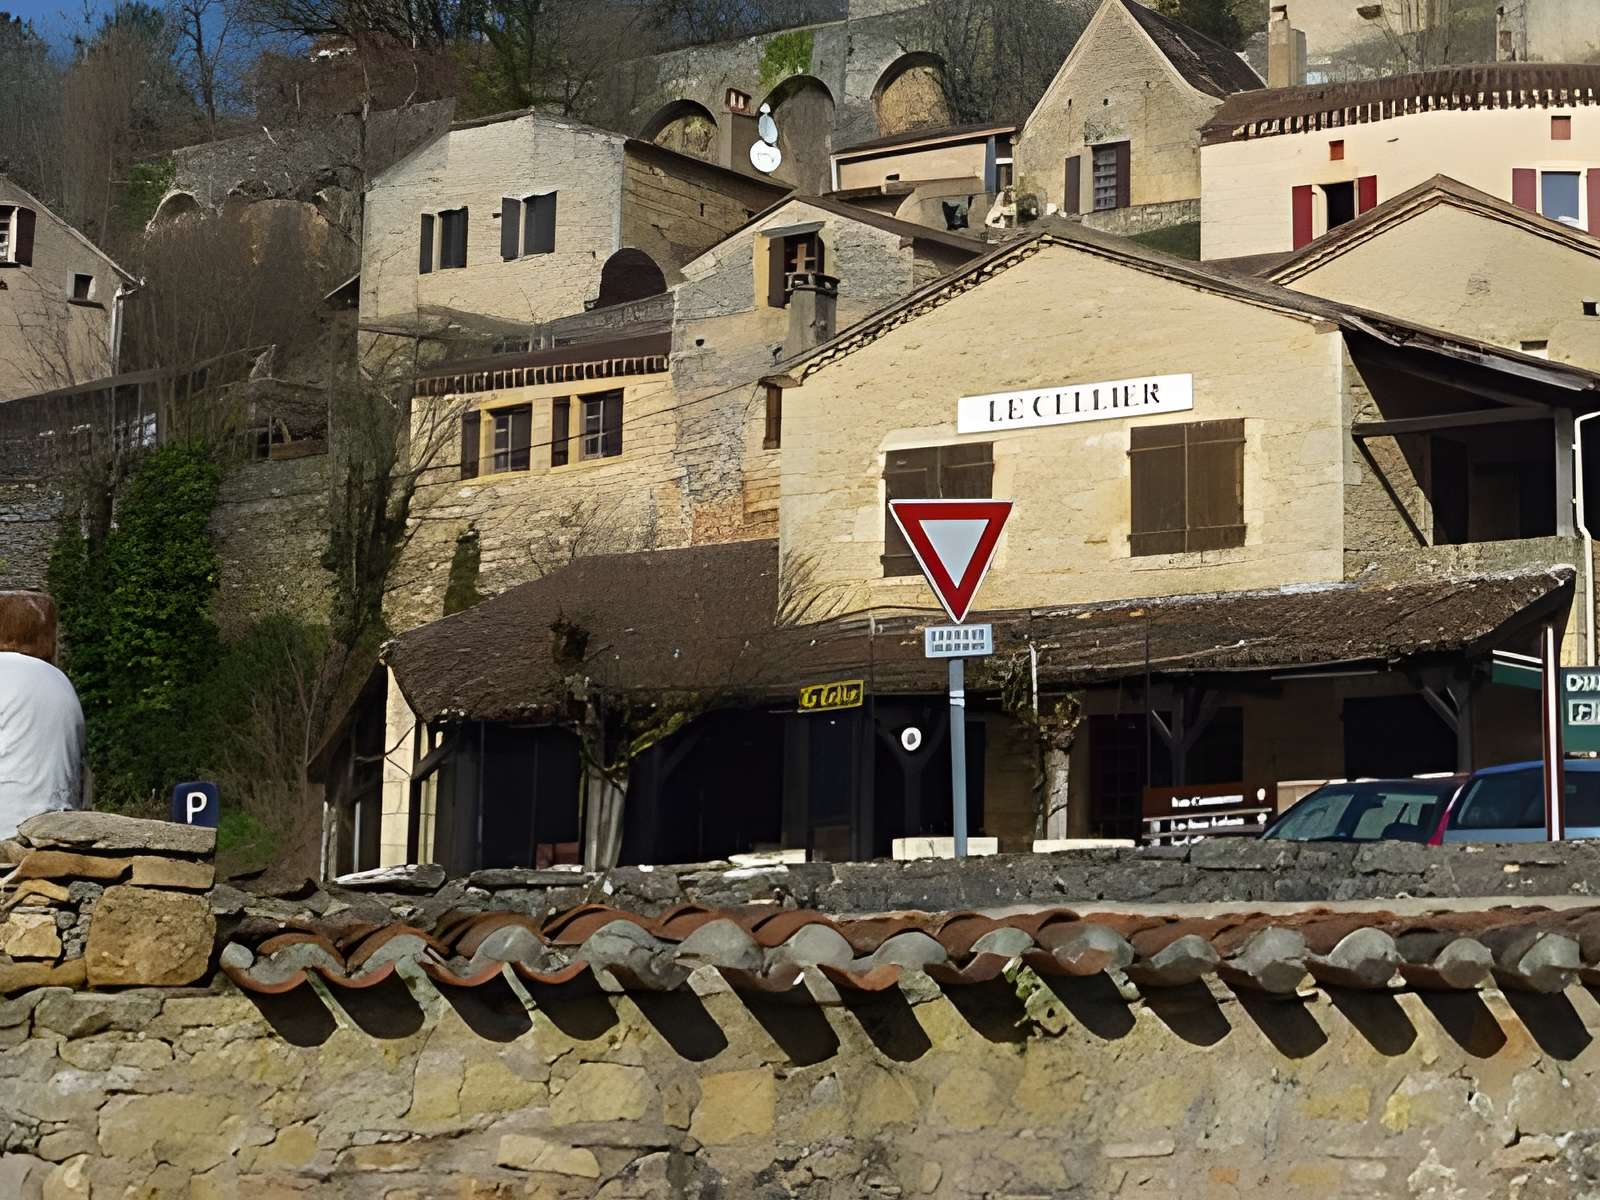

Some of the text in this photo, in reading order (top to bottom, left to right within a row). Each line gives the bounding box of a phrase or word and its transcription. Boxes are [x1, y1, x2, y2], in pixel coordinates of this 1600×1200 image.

[989, 383, 1160, 422] LE CELLIER
[186, 791, 208, 825] P
